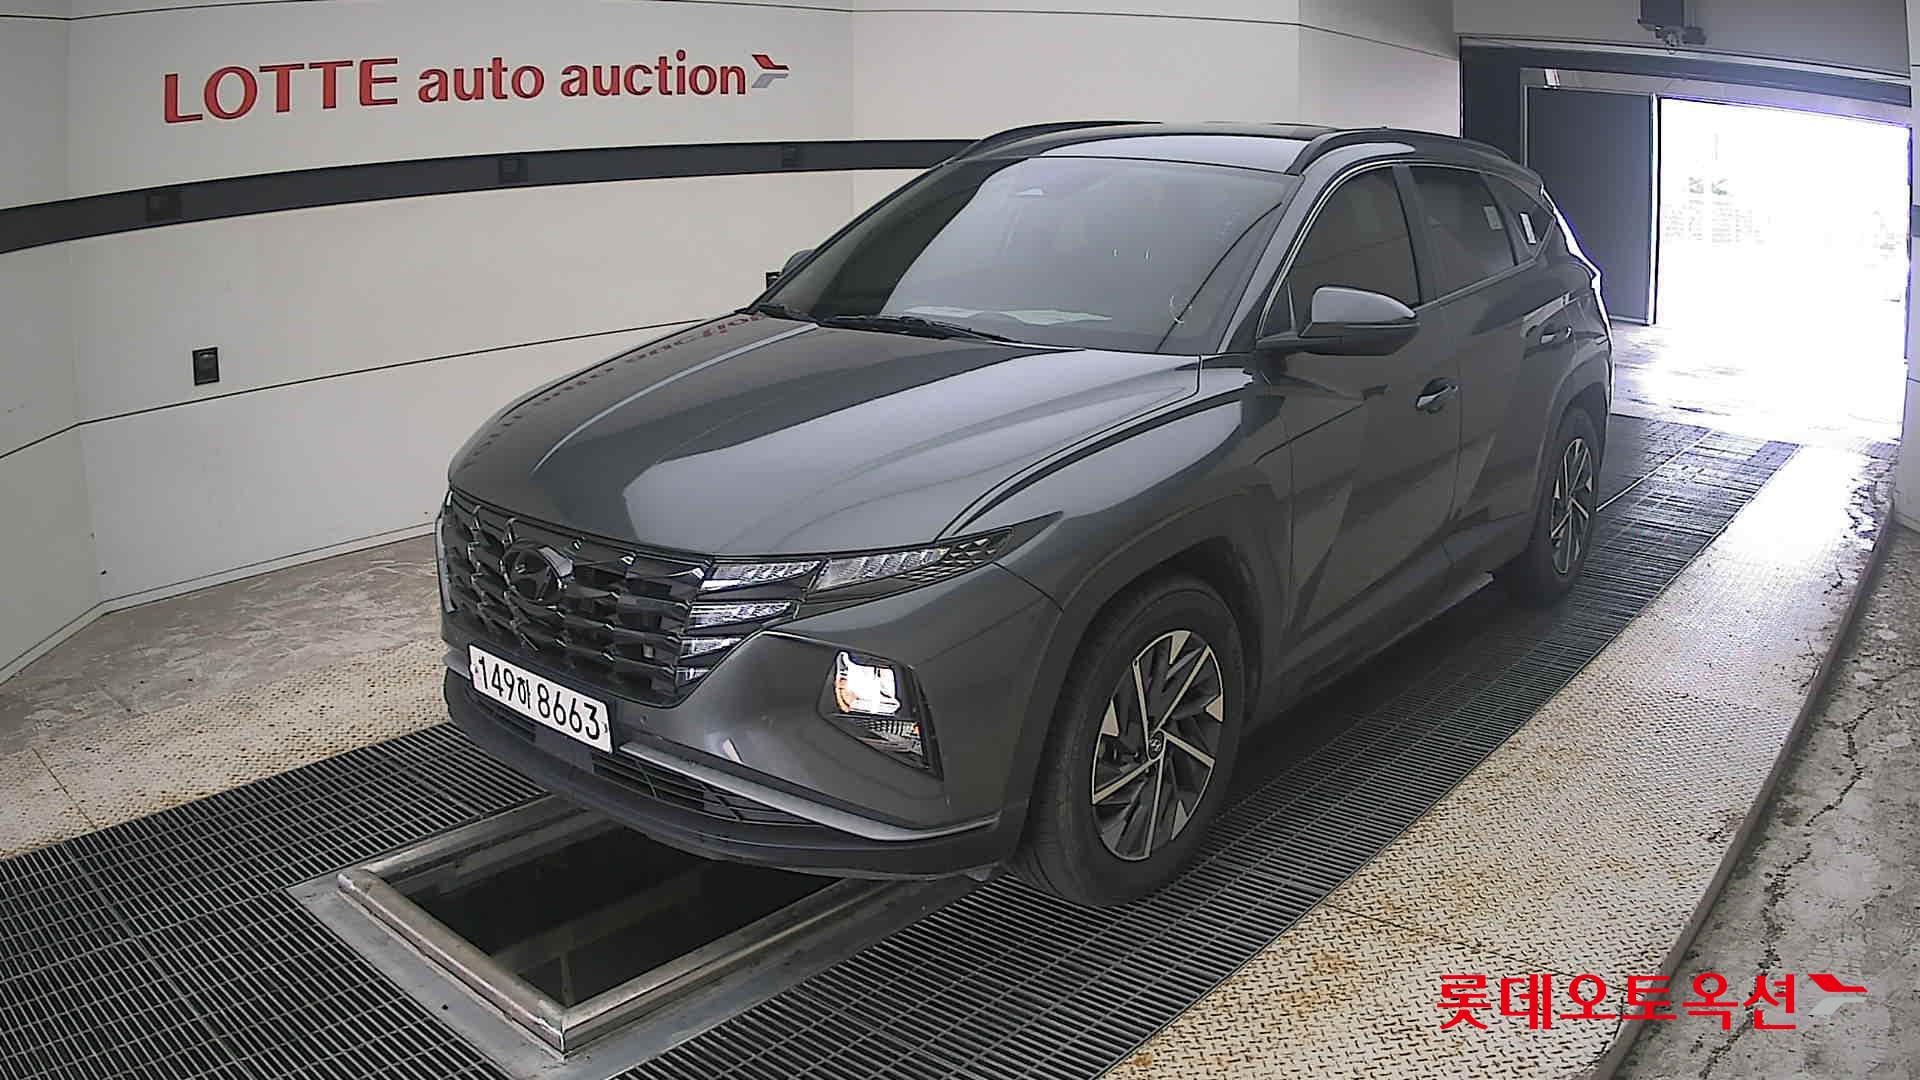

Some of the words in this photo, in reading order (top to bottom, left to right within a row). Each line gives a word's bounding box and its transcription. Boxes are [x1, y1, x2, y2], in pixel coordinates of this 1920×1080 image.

[164, 57, 398, 123] LOTTE
[418, 56, 545, 103] auto
[560, 49, 747, 97] auction
